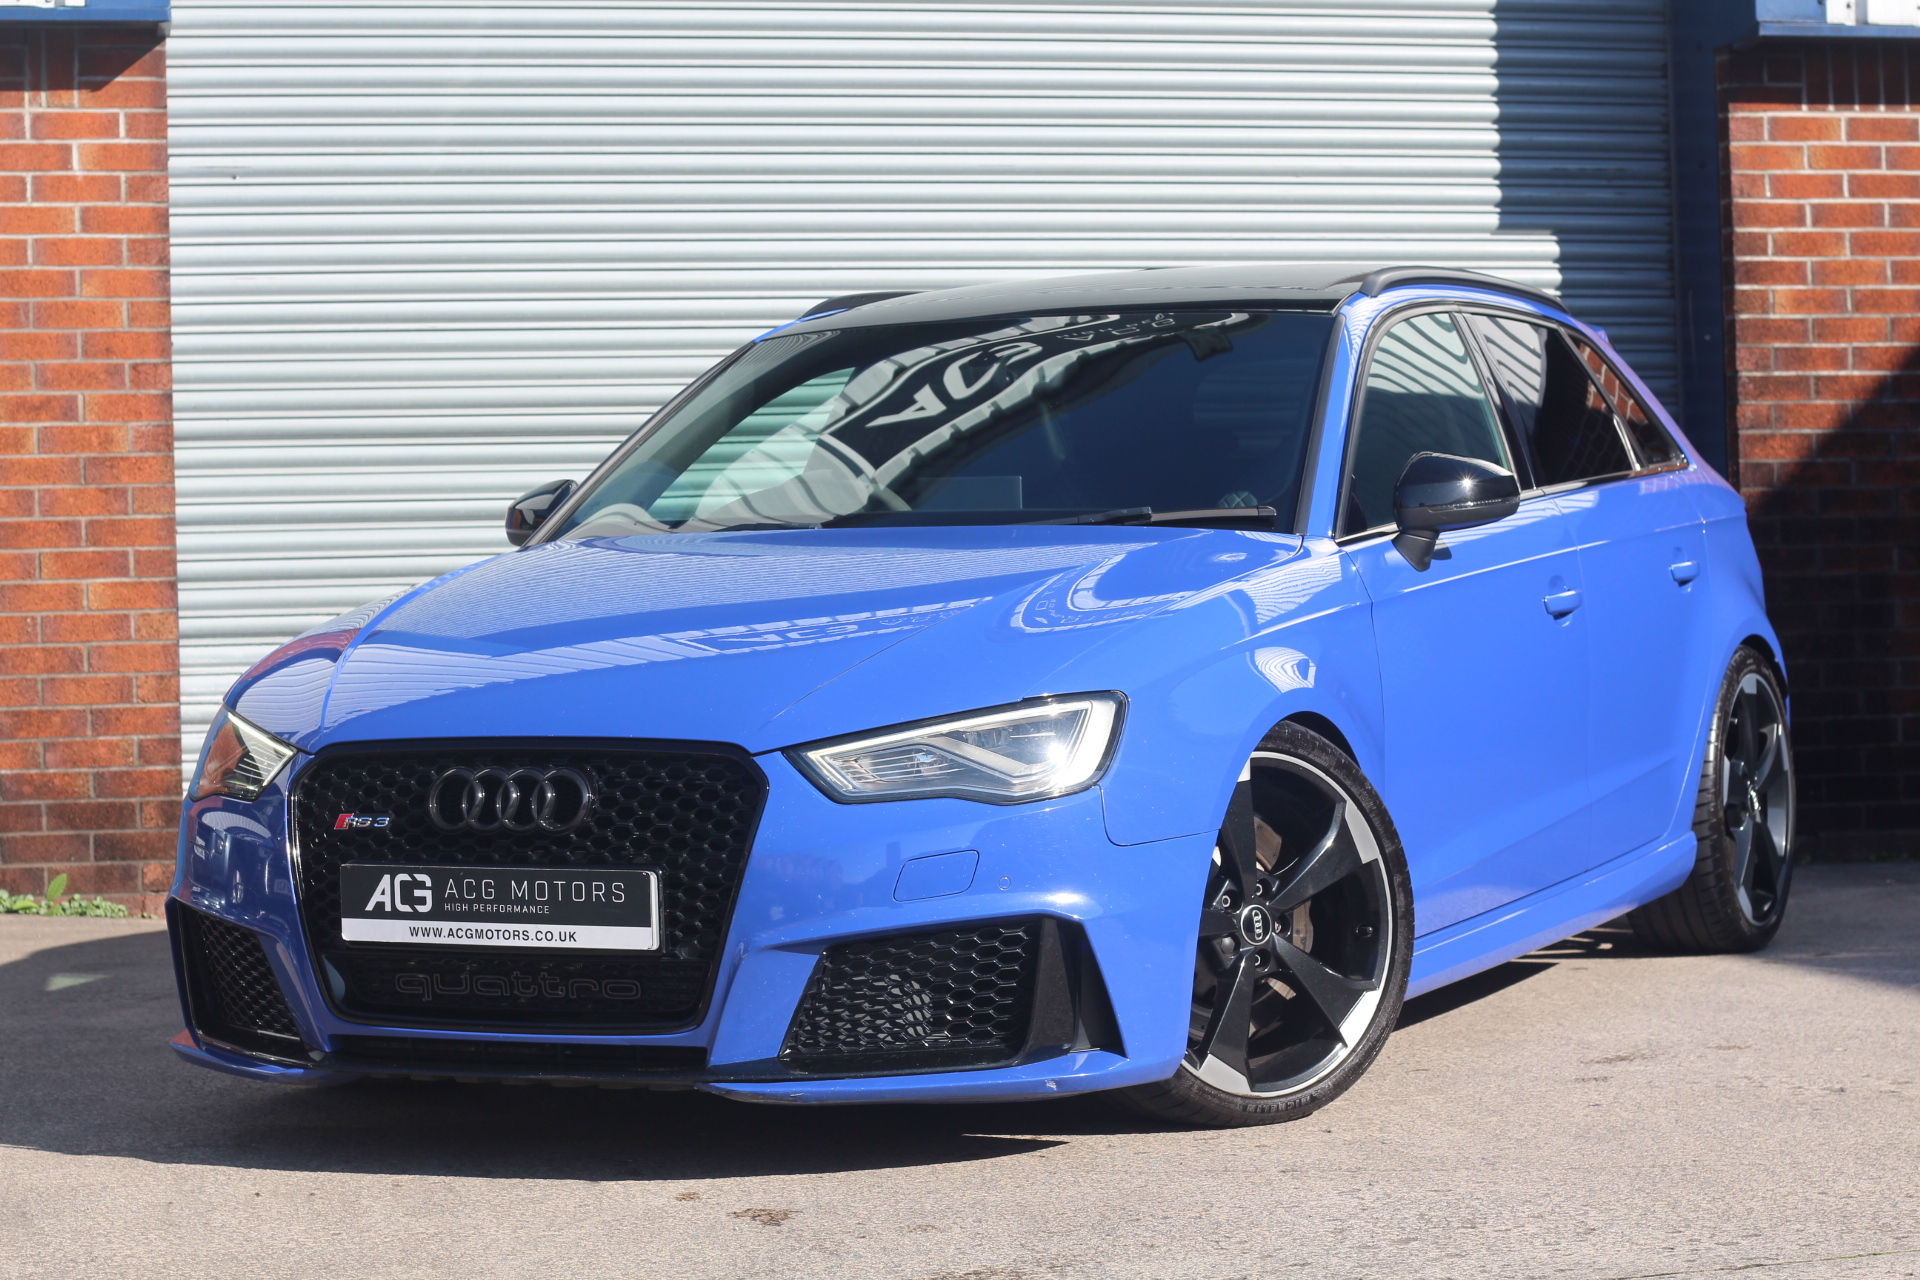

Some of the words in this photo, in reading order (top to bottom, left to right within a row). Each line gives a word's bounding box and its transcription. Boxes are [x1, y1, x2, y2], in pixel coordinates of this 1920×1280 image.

[364, 873, 433, 913] ACG
[444, 878, 495, 900] ACG
[511, 880, 626, 903] MOTORS
[444, 902, 469, 912] HIGH
[473, 902, 550, 914] PERFORMANCE
[408, 926, 578, 943] WWW.ACGMOTORS.CO.UK
[395, 971, 642, 1000] quattro
